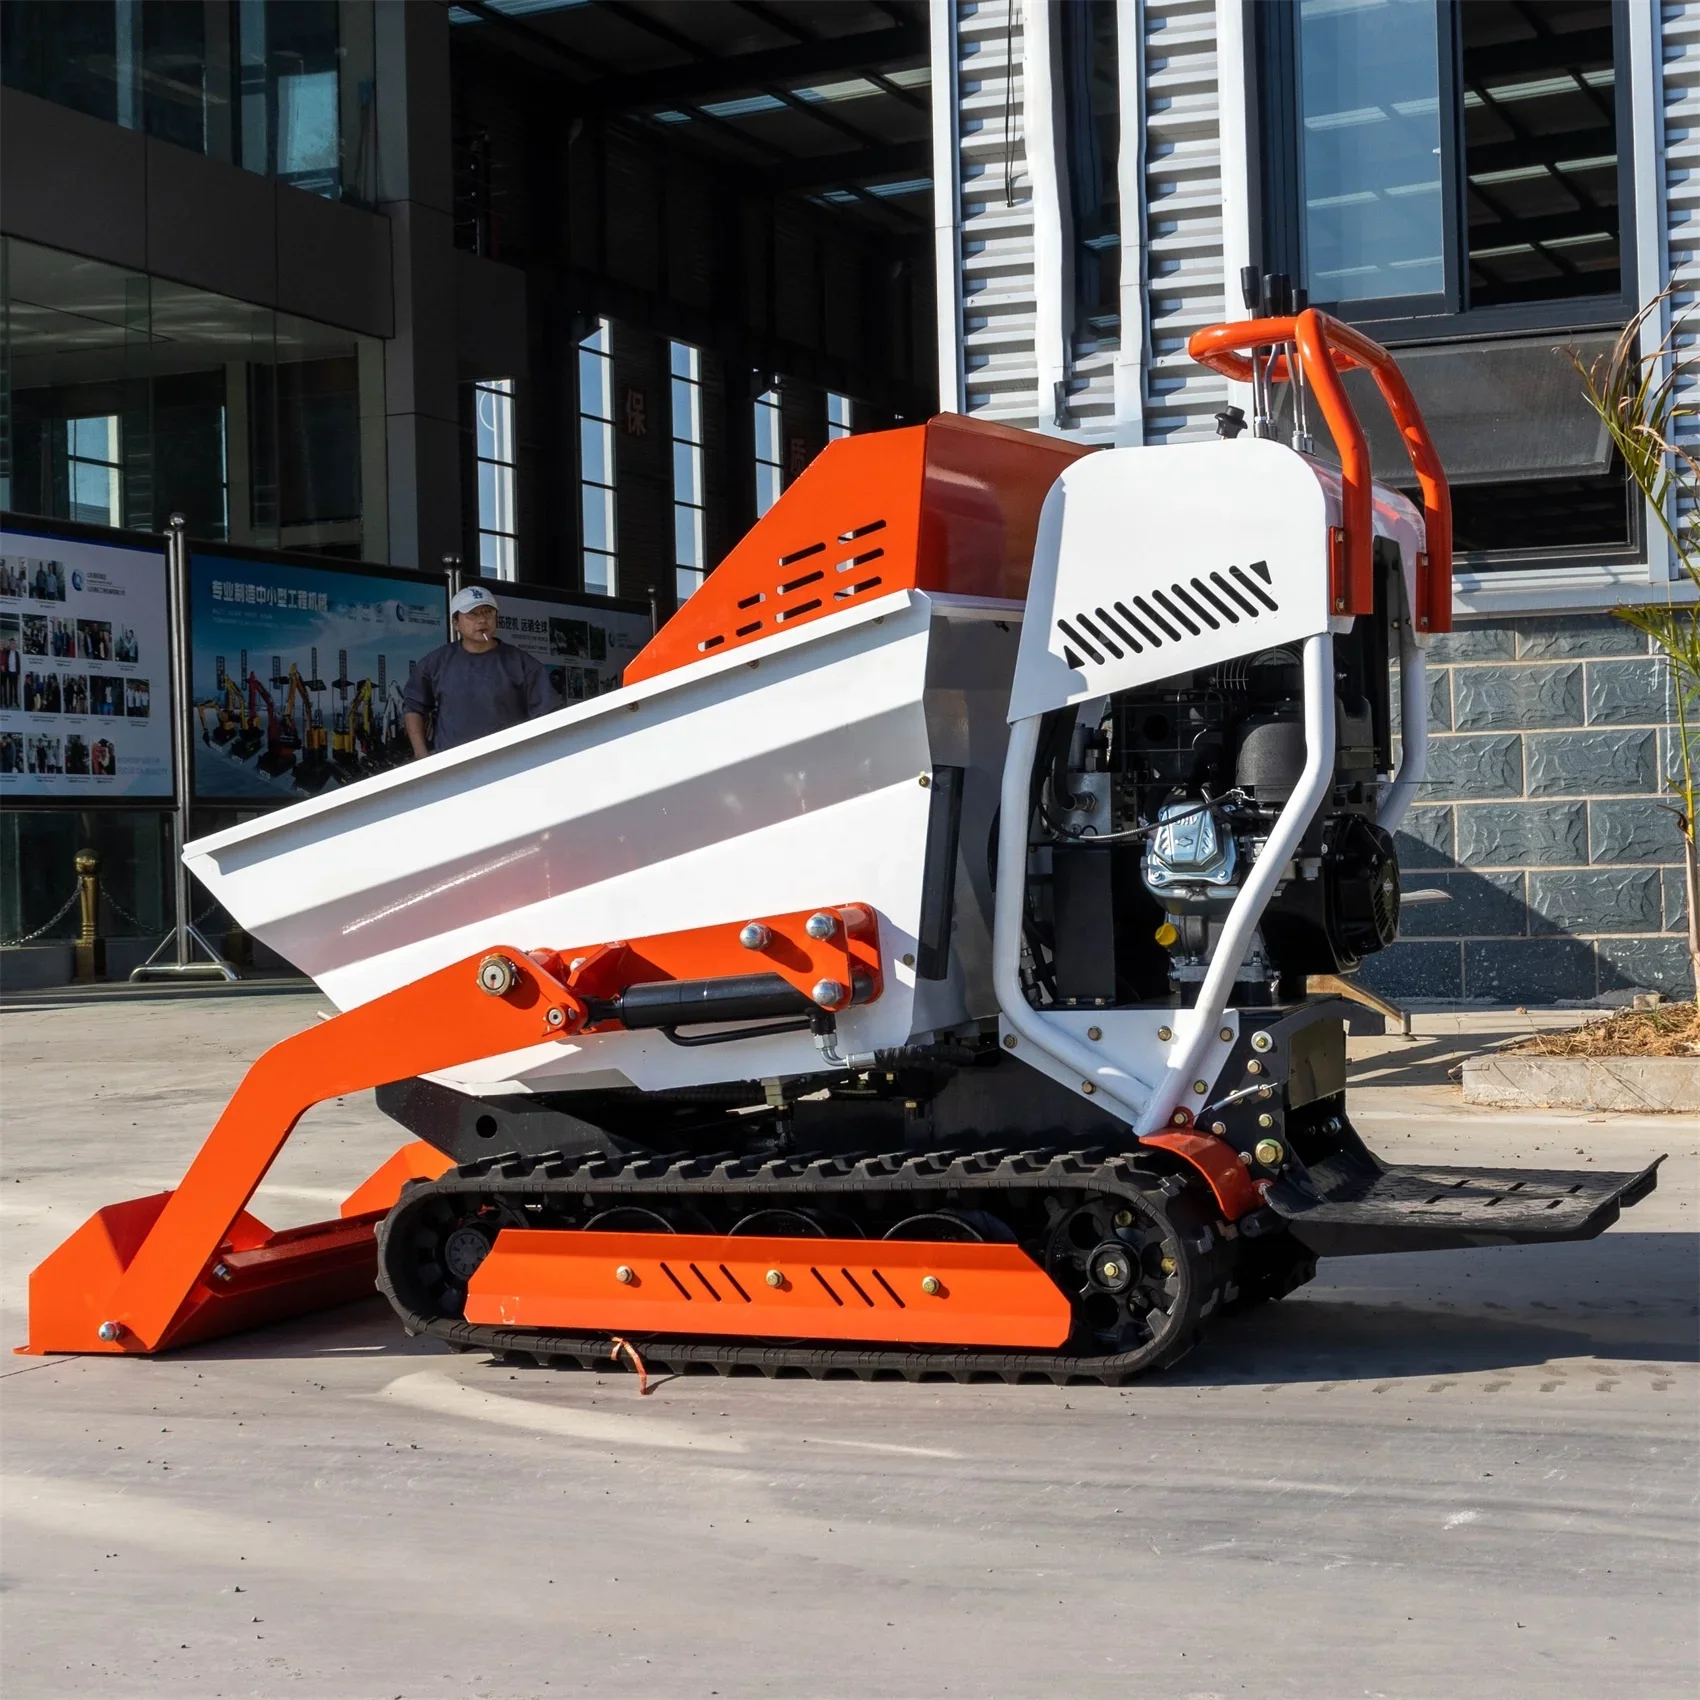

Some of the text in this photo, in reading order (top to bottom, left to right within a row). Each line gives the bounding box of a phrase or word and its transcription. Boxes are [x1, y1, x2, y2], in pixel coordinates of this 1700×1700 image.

[626, 388, 647, 436] 保
[212, 580, 328, 612] 专业制造中小型工程机械
[496, 615, 548, 634] 拓挖机 远销全球
